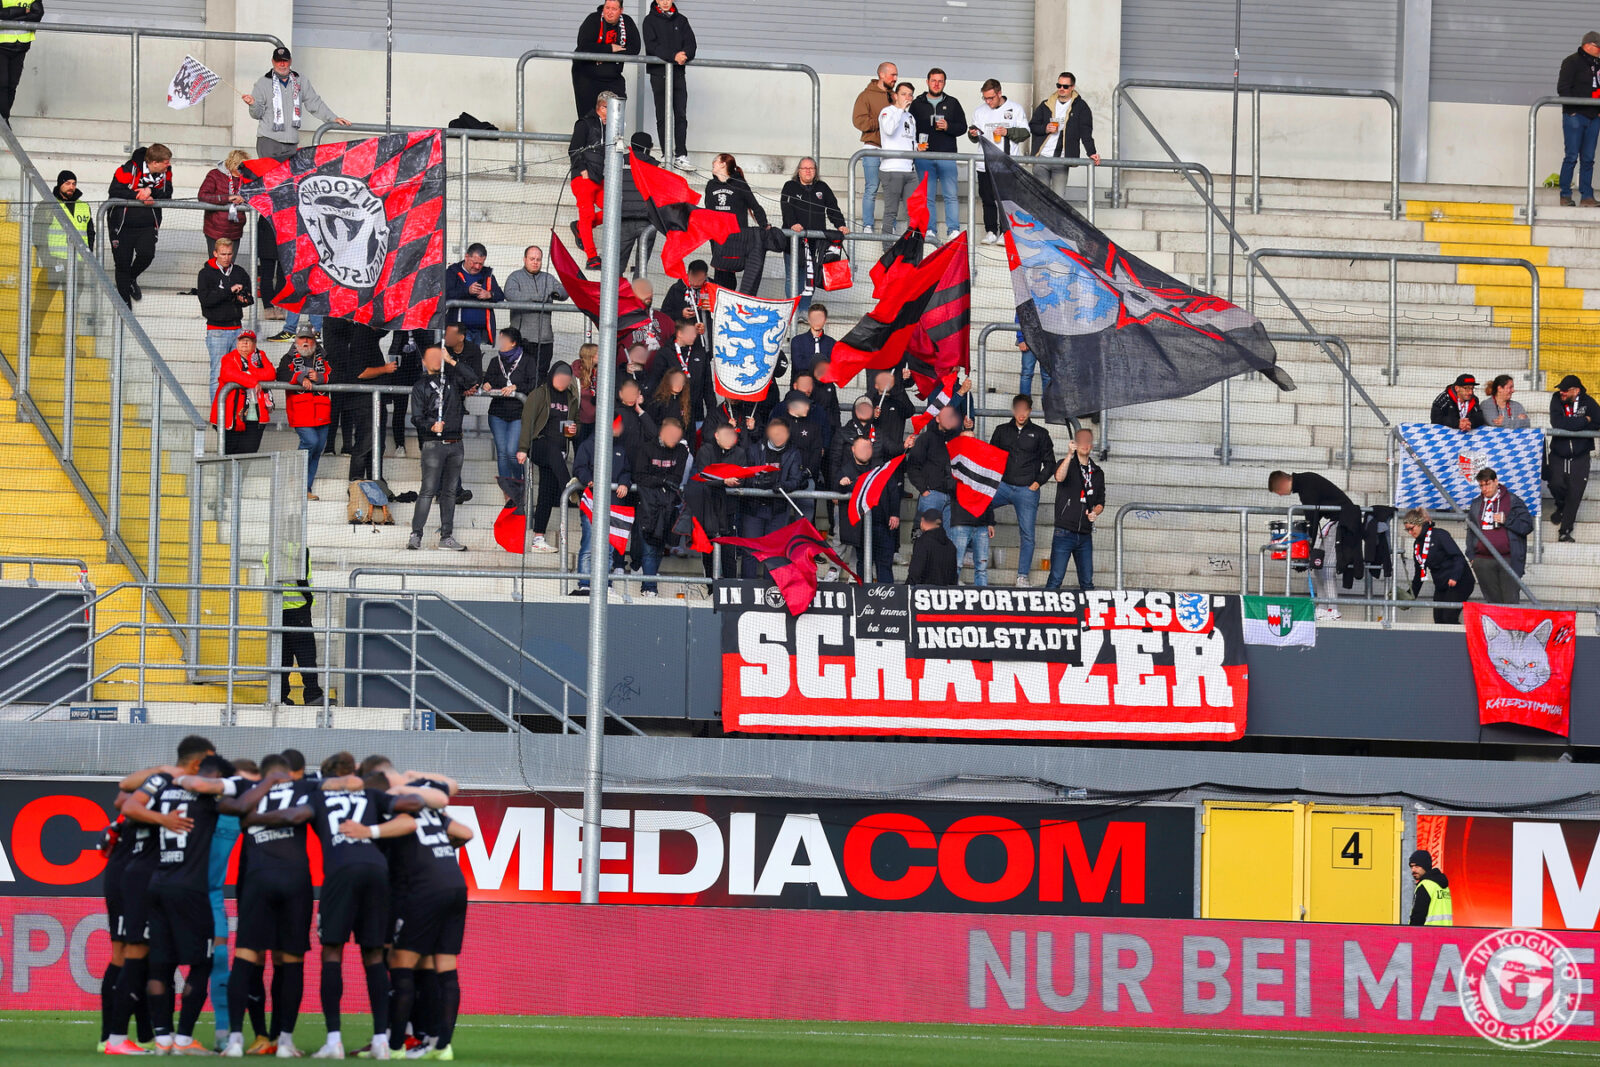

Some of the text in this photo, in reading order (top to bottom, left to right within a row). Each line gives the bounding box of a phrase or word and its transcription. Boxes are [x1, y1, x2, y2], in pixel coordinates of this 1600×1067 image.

[719, 587, 742, 605] IN
[867, 585, 896, 600] Mofo
[914, 589, 1076, 613] SUPPORTERS
[880, 607, 908, 617] immer
[1083, 590, 1172, 628] FKS
[867, 622, 900, 634] bei uns
[917, 626, 1078, 651] INGOLSTADT
[325, 796, 369, 836] 27
[446, 805, 1147, 905] MEDIACOM
[1341, 831, 1363, 866] 4
[968, 928, 1154, 1014] NUR
[1182, 935, 1311, 1018] BEI
